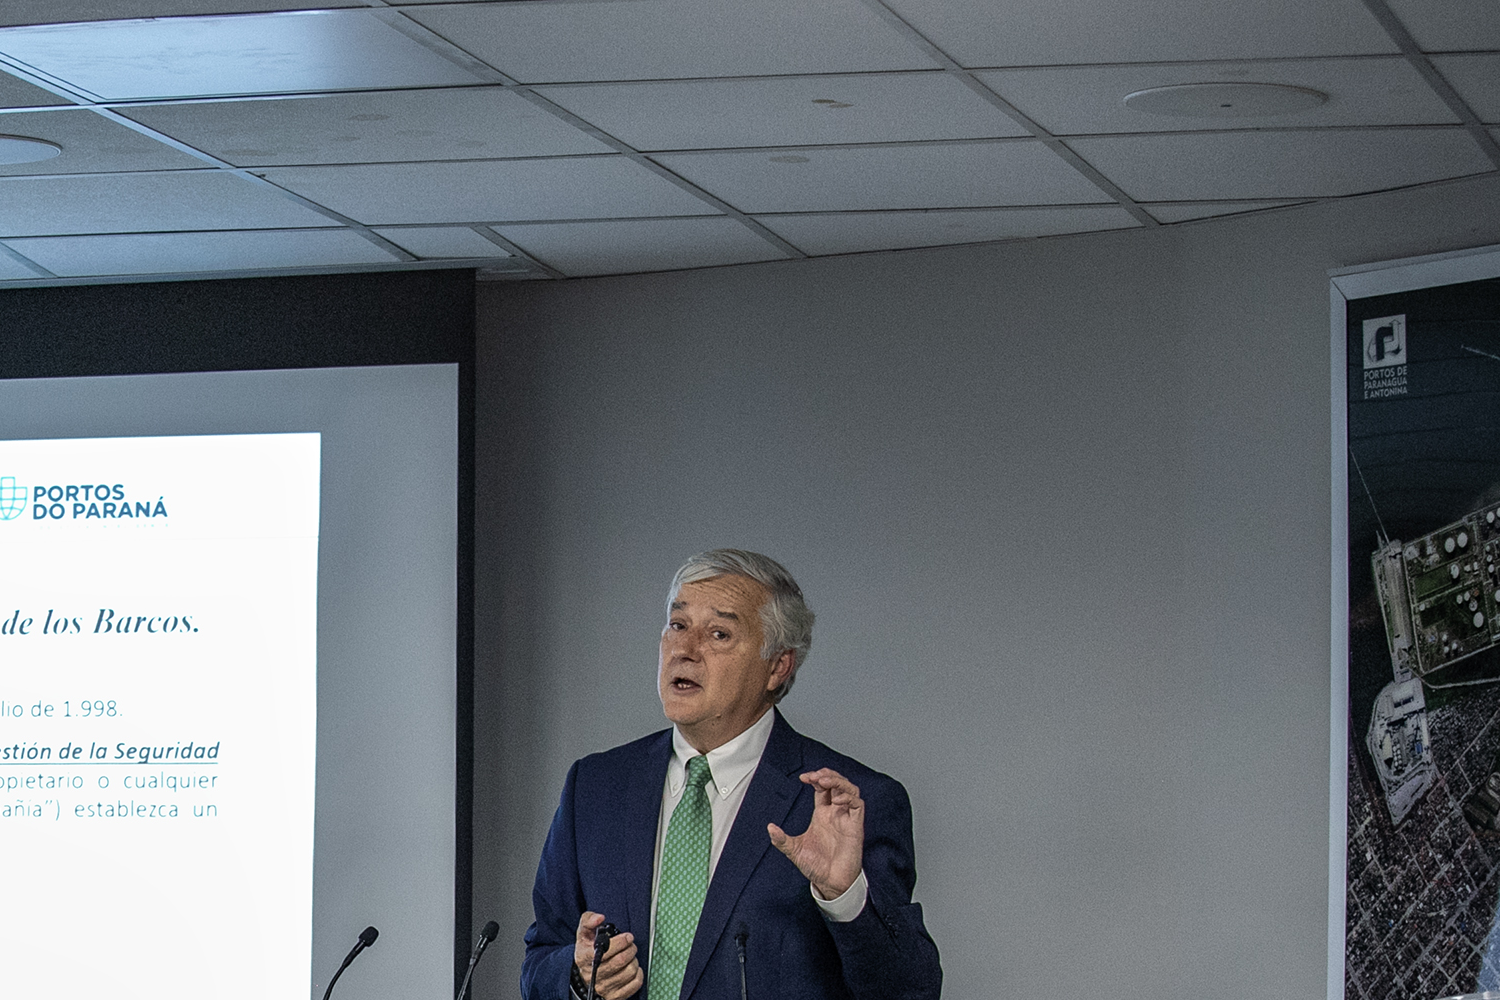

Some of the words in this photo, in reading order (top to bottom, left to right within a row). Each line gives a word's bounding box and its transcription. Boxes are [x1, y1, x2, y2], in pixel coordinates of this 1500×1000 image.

[1364, 368, 1395, 380] PORTOS
[1397, 366, 1407, 376] DE
[1364, 391, 1369, 399] E
[1370, 387, 1407, 398] ANTONINA
[33, 484, 125, 503] PORTOS
[33, 503, 66, 520] DO
[72, 496, 168, 519] PARANÁ
[1, 609, 33, 635] de
[43, 609, 82, 635] los
[93, 609, 198, 633] Barcos.
[31, 700, 54, 717] de
[64, 700, 122, 717] 1.998.
[59, 742, 83, 760] de
[89, 742, 107, 760] la
[114, 742, 219, 763] Seguridad
[98, 776, 109, 789] o
[124, 771, 218, 792] cualquier
[75, 800, 178, 817] establezca
[194, 805, 217, 817] un
